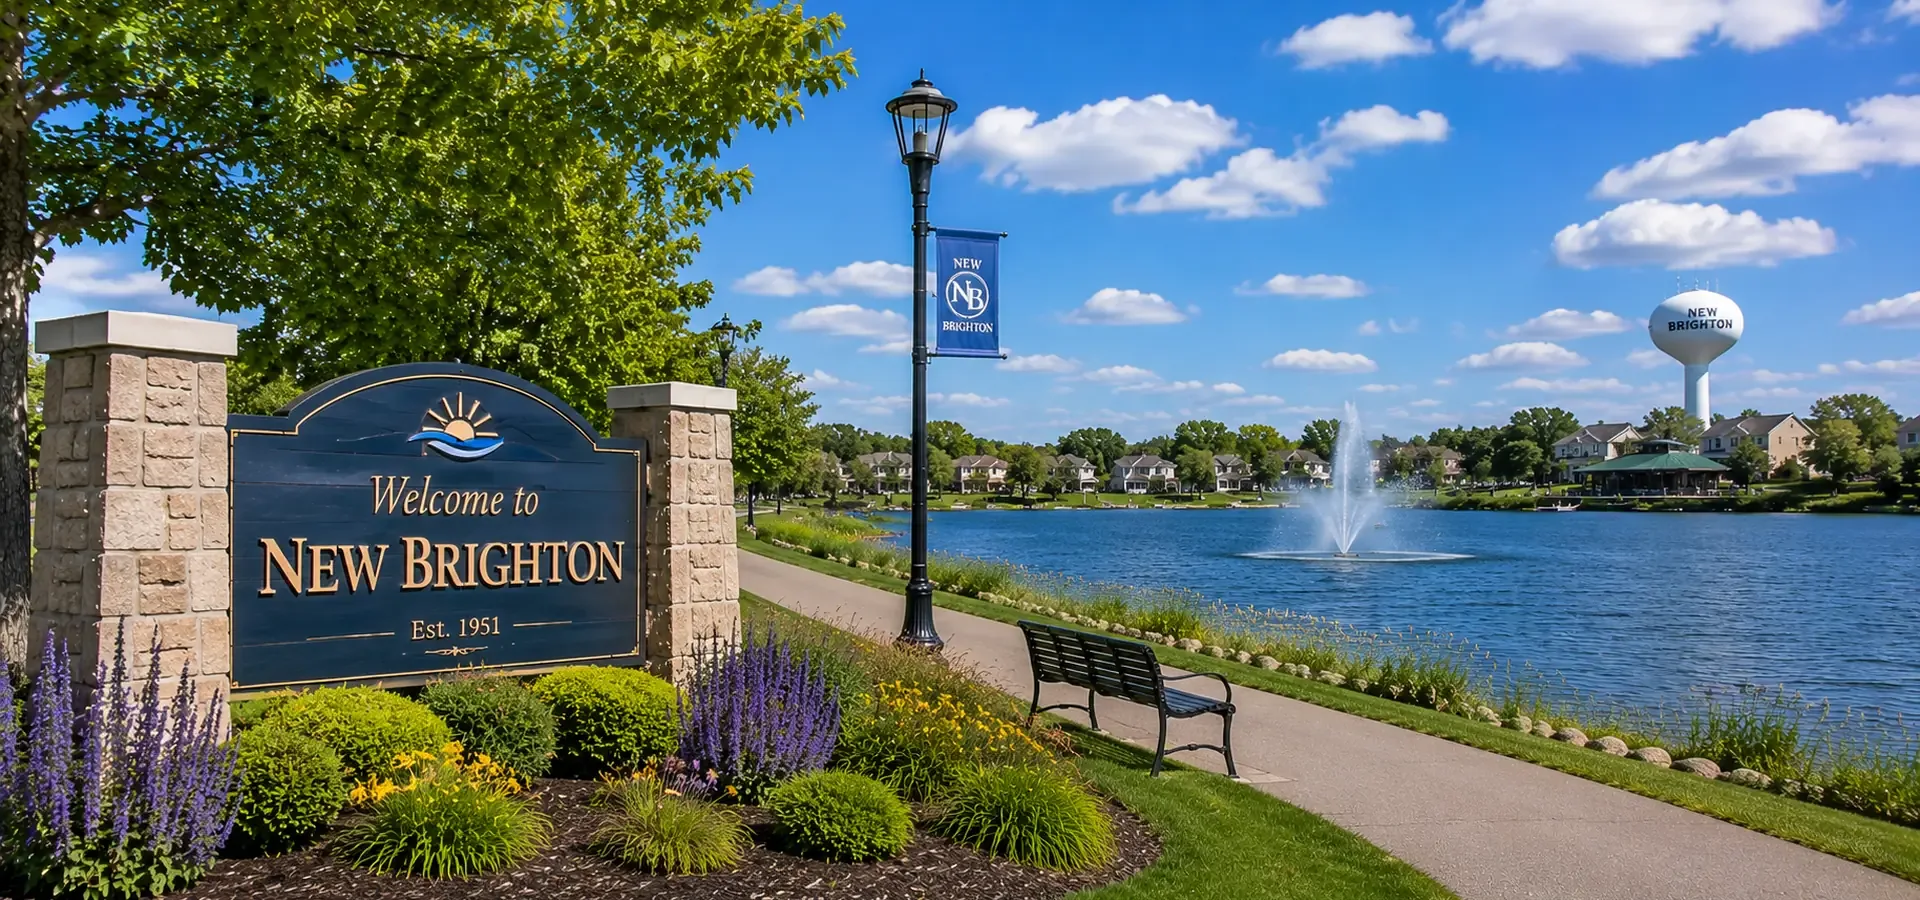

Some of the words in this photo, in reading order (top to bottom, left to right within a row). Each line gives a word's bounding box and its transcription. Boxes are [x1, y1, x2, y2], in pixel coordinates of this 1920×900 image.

[953, 258, 982, 269] NEW
[951, 280, 985, 310] NB
[1687, 308, 1718, 318] NEW
[943, 321, 993, 333] BRIGHTON
[1668, 319, 1733, 331] BRIGHTON
[370, 475, 504, 516] Welcome
[512, 487, 539, 516] to
[258, 537, 390, 596] NEW
[400, 536, 625, 590] BRIGHTON
[411, 620, 450, 641] Est.
[458, 616, 501, 638] 1951
